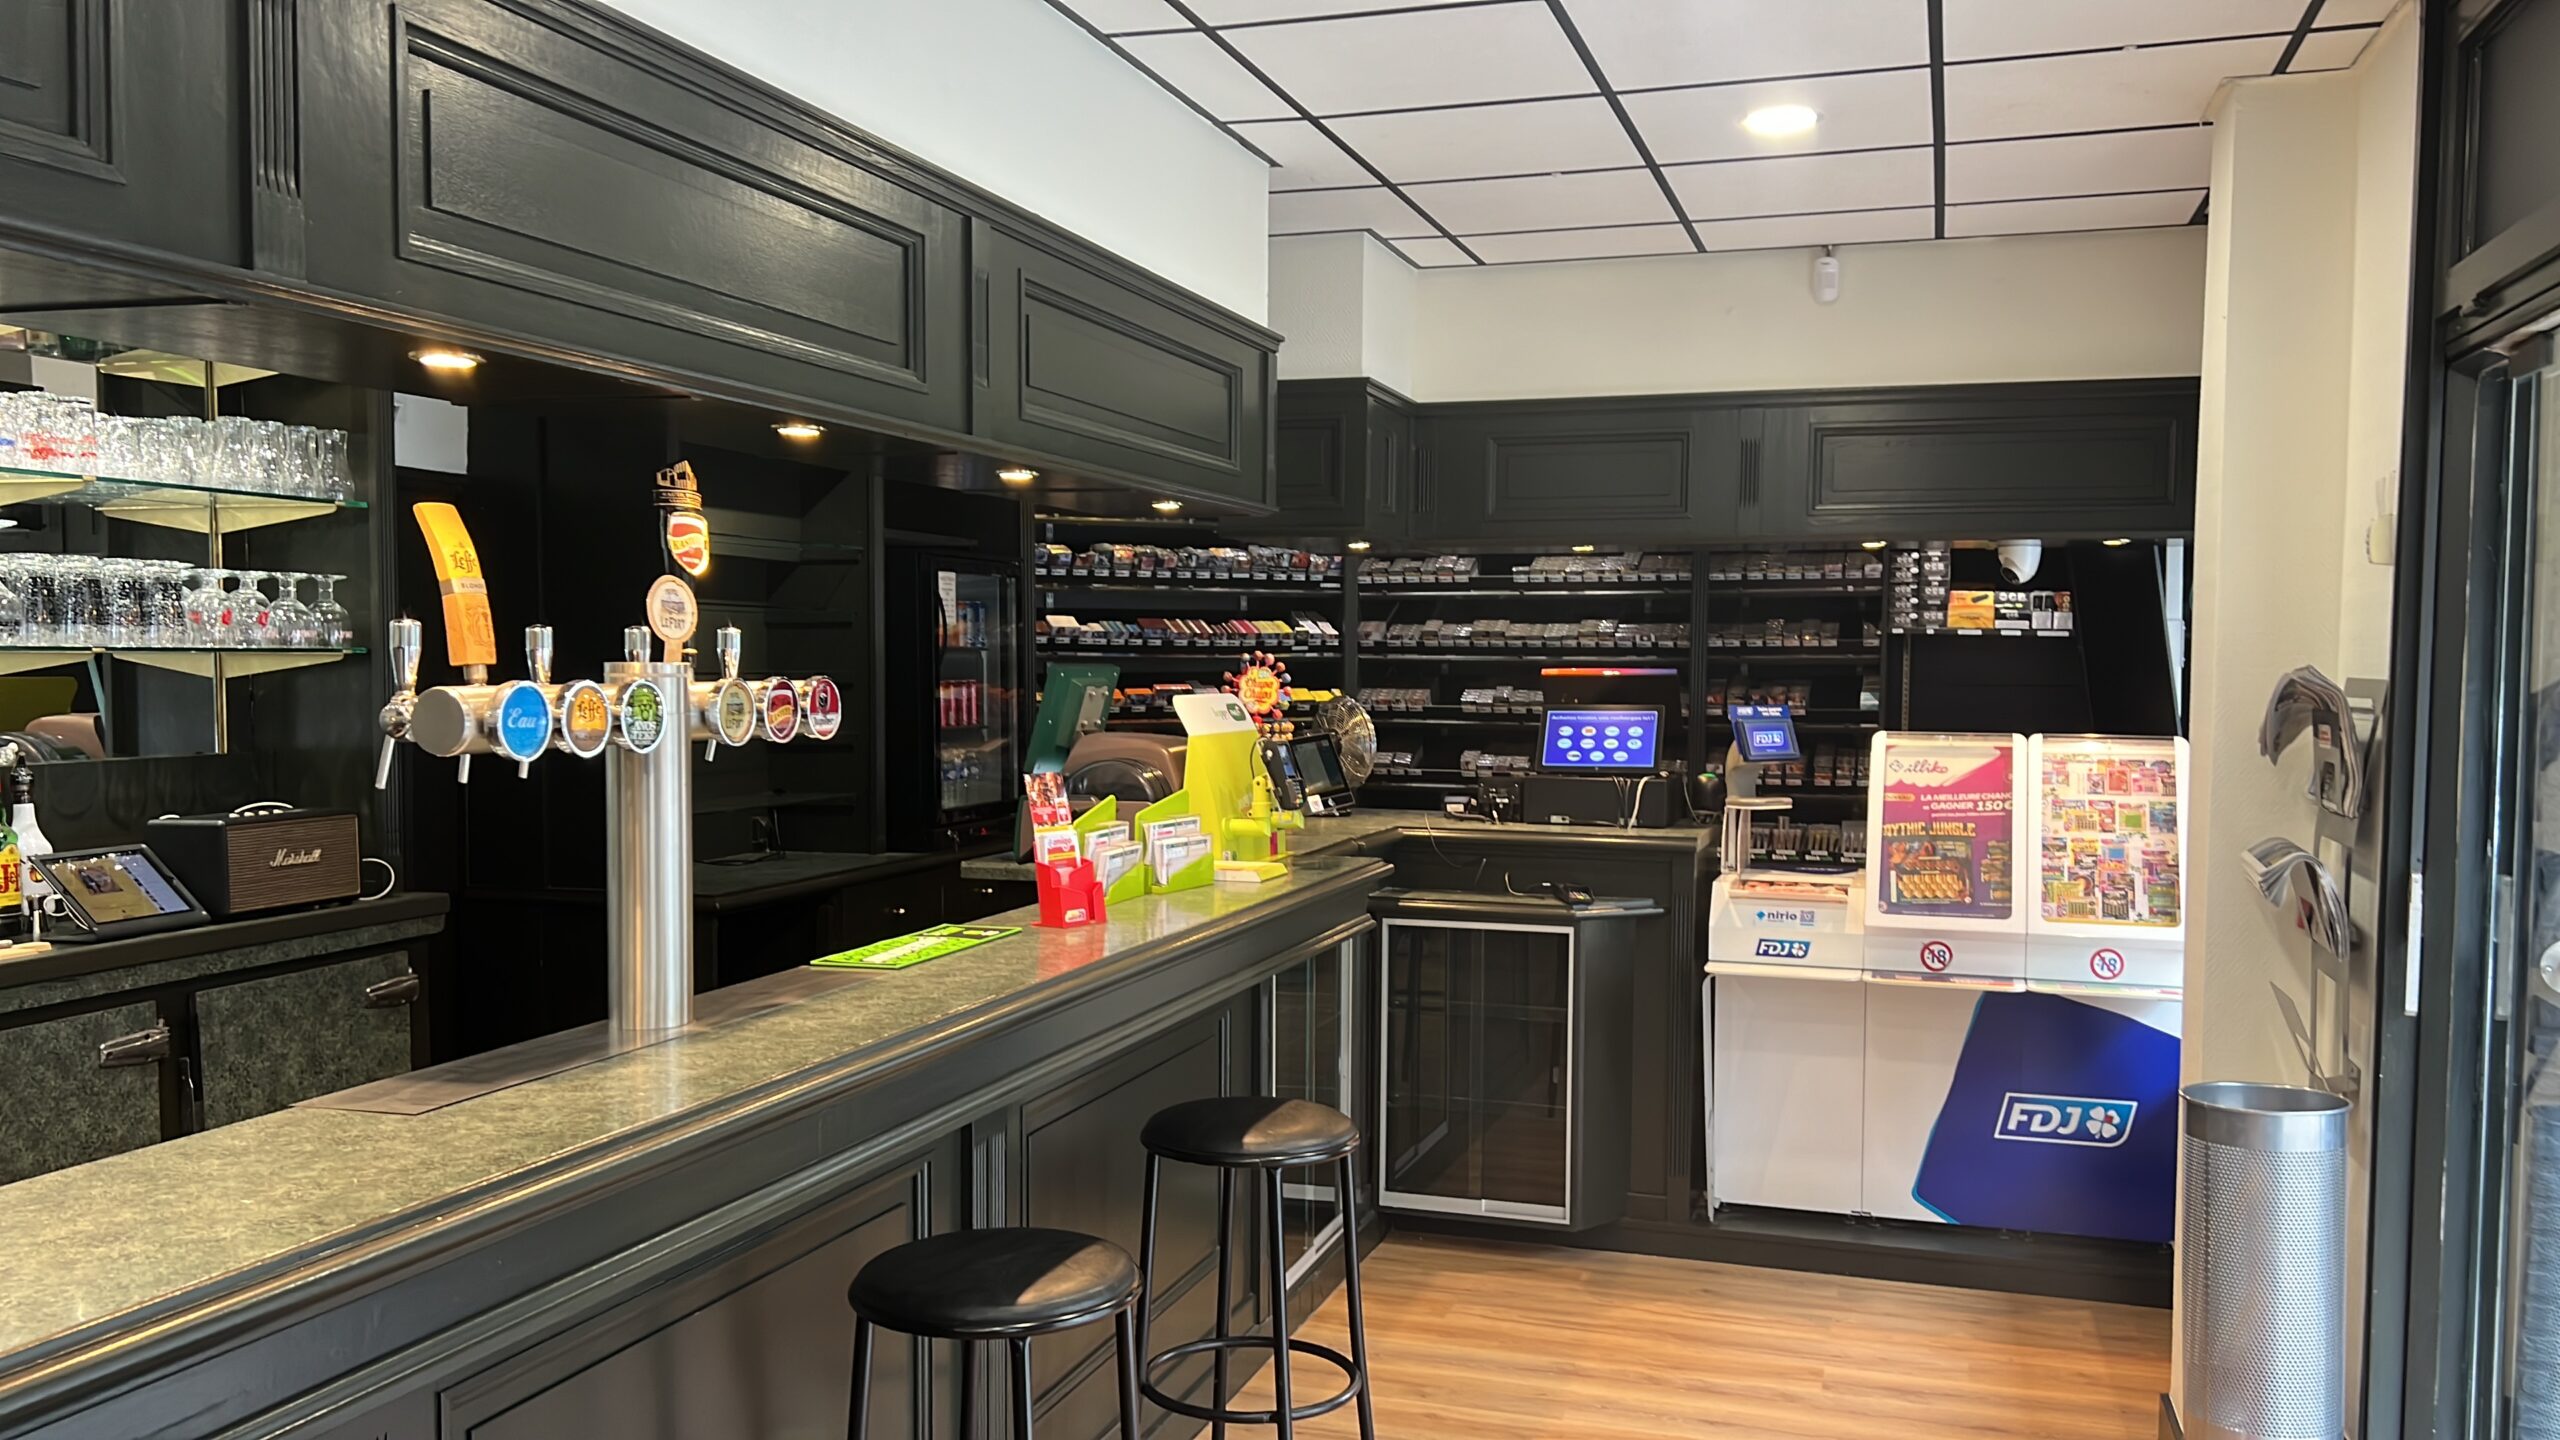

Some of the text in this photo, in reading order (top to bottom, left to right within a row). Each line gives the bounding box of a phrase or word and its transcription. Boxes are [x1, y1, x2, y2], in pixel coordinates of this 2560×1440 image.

[1999, 592, 2027, 602] OCB
[508, 707, 536, 728] Eau
[1904, 760, 1949, 774] illiko
[1920, 793, 1932, 801] LA
[1931, 802, 1974, 811] GAGNER
[1929, 821, 1976, 837] JUNGLE
[269, 848, 322, 867] Marshall
[1767, 910, 1798, 921] nirio
[1758, 941, 1790, 956] FDJ
[2007, 1102, 2083, 1135] FDJ
